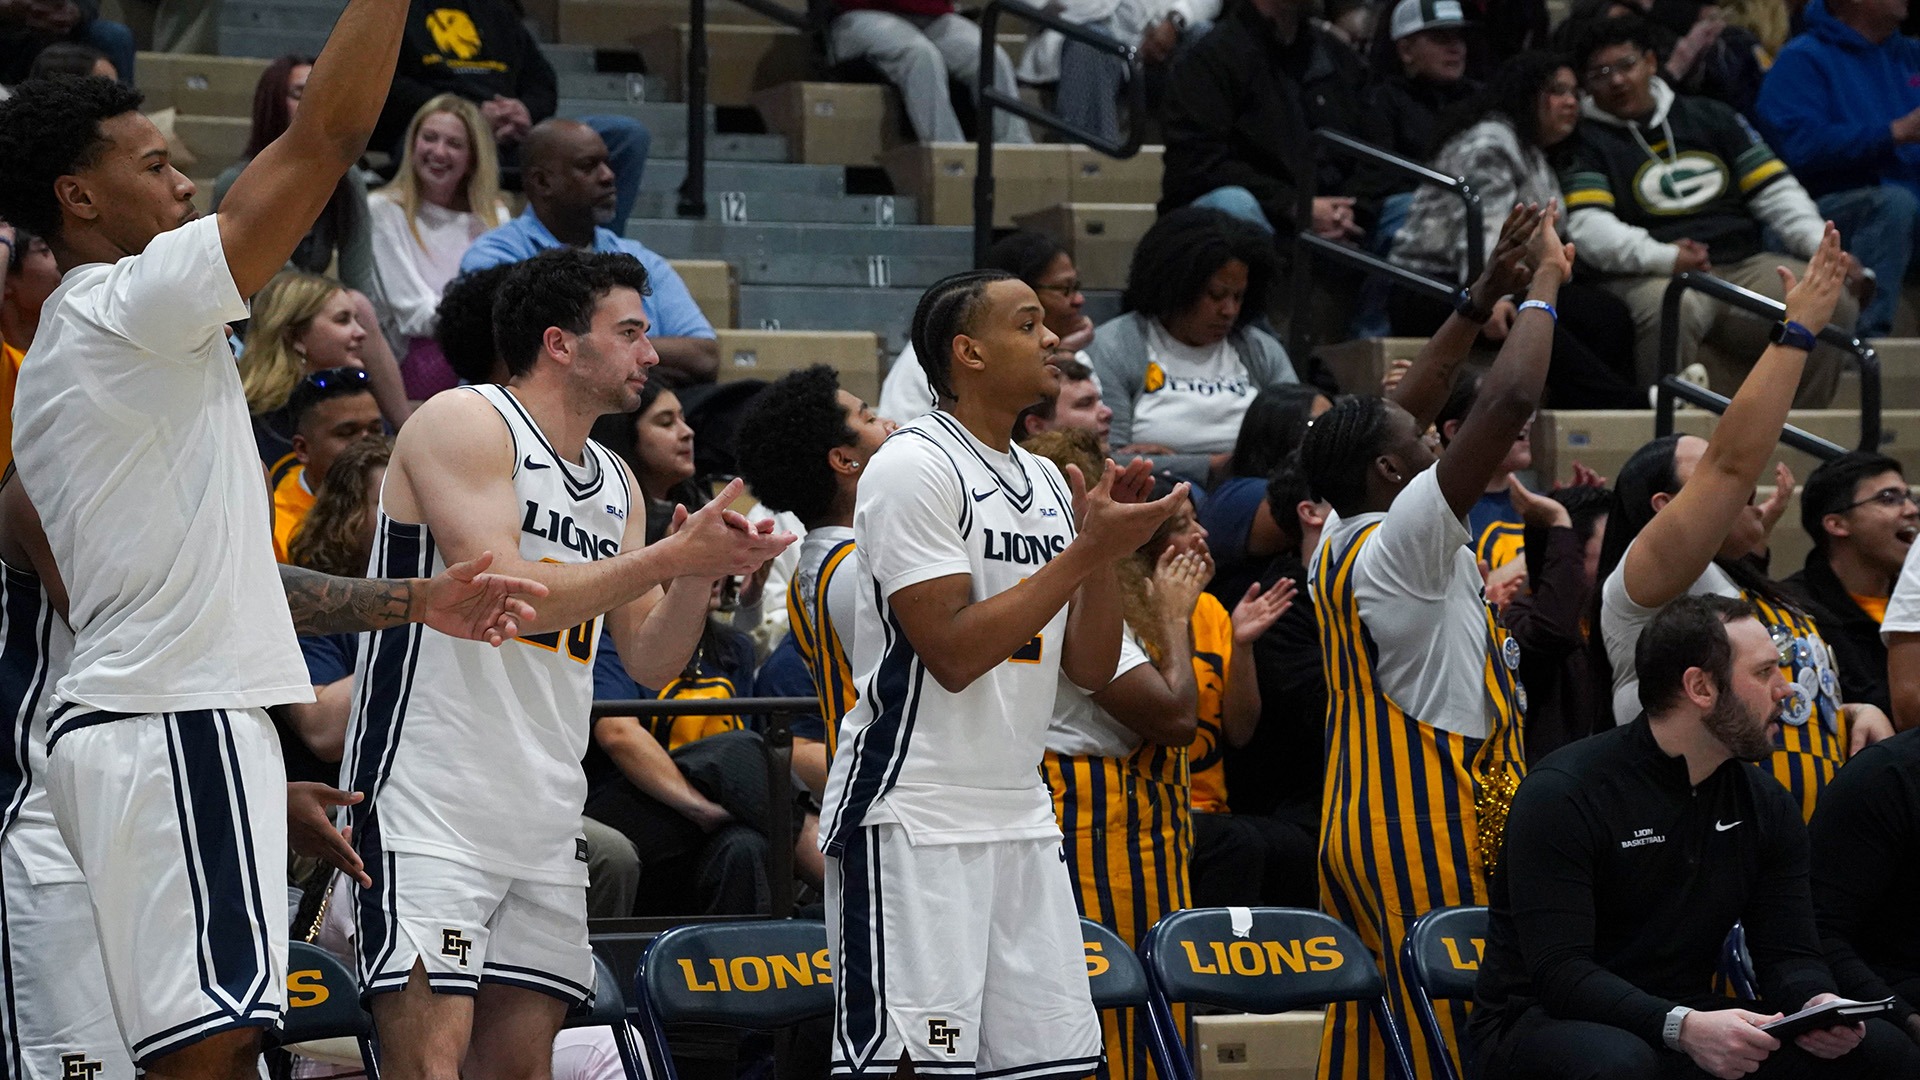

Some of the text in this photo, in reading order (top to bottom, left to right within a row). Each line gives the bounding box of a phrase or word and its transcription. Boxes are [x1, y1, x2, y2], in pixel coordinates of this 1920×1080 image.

[1638, 155, 1724, 210] G
[521, 500, 619, 562] LIONS
[983, 528, 1066, 565] LIONS
[1633, 828, 1654, 838] LION
[441, 928, 473, 967] ET
[1180, 936, 1345, 976] LIONS
[927, 1018, 961, 1056] ET
